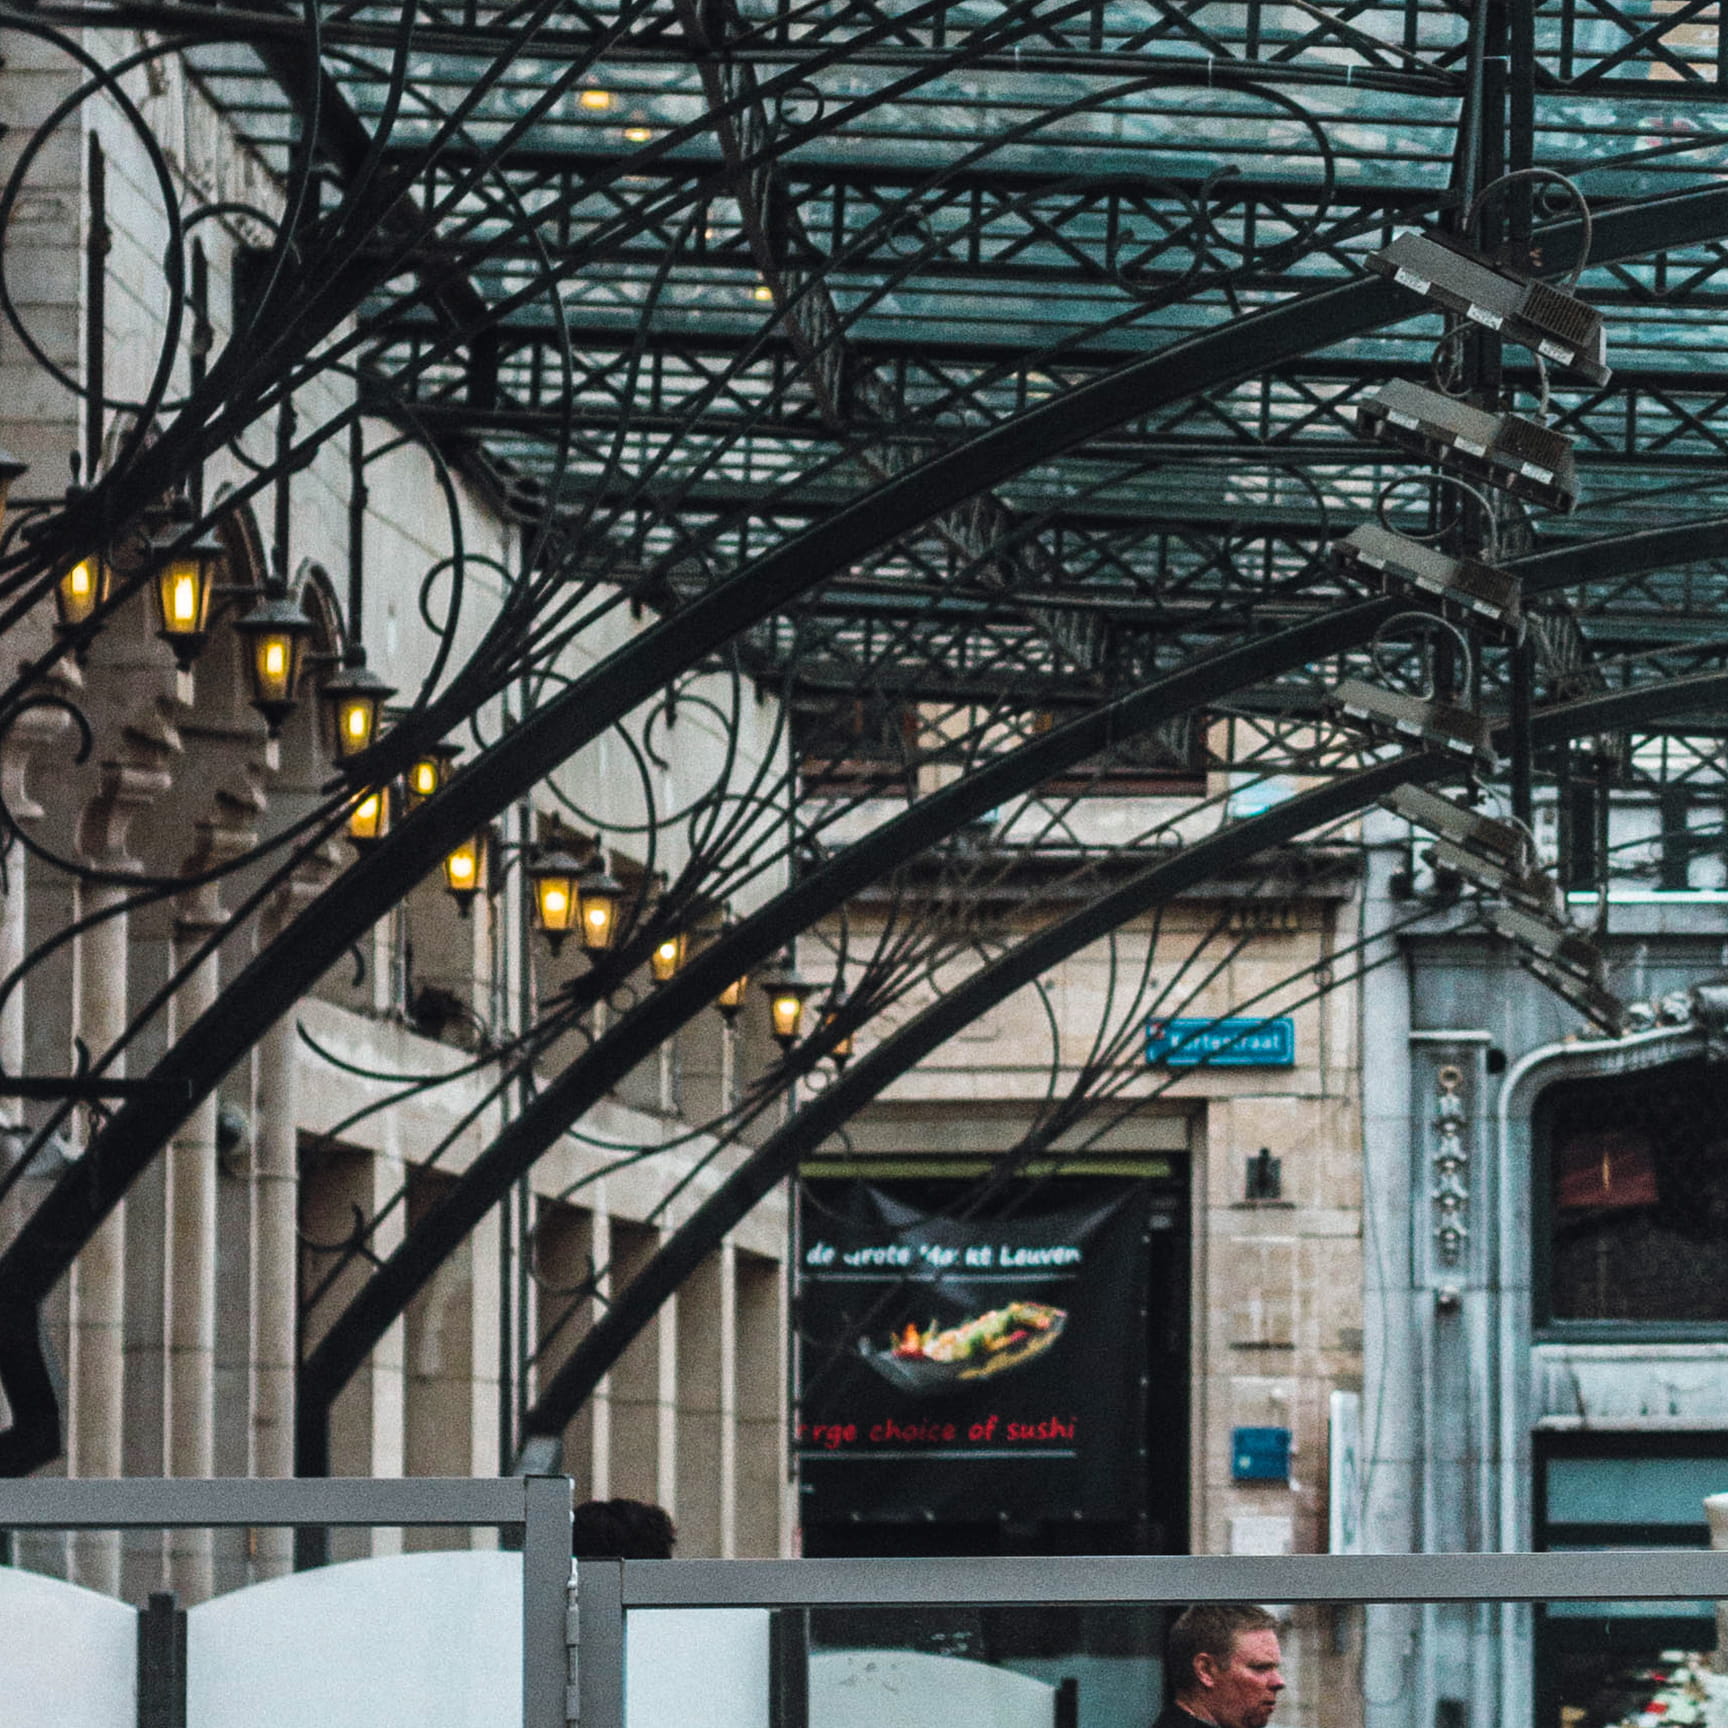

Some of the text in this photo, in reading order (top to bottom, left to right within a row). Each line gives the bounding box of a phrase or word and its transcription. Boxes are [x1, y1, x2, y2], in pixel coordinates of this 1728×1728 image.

[1170, 1031, 1281, 1050] Krtesraat
[806, 1240, 836, 1266] de
[999, 1242, 1082, 1267] Leuven
[868, 1417, 957, 1443] choice
[967, 1414, 999, 1441] of
[1006, 1415, 1079, 1441] sushi
